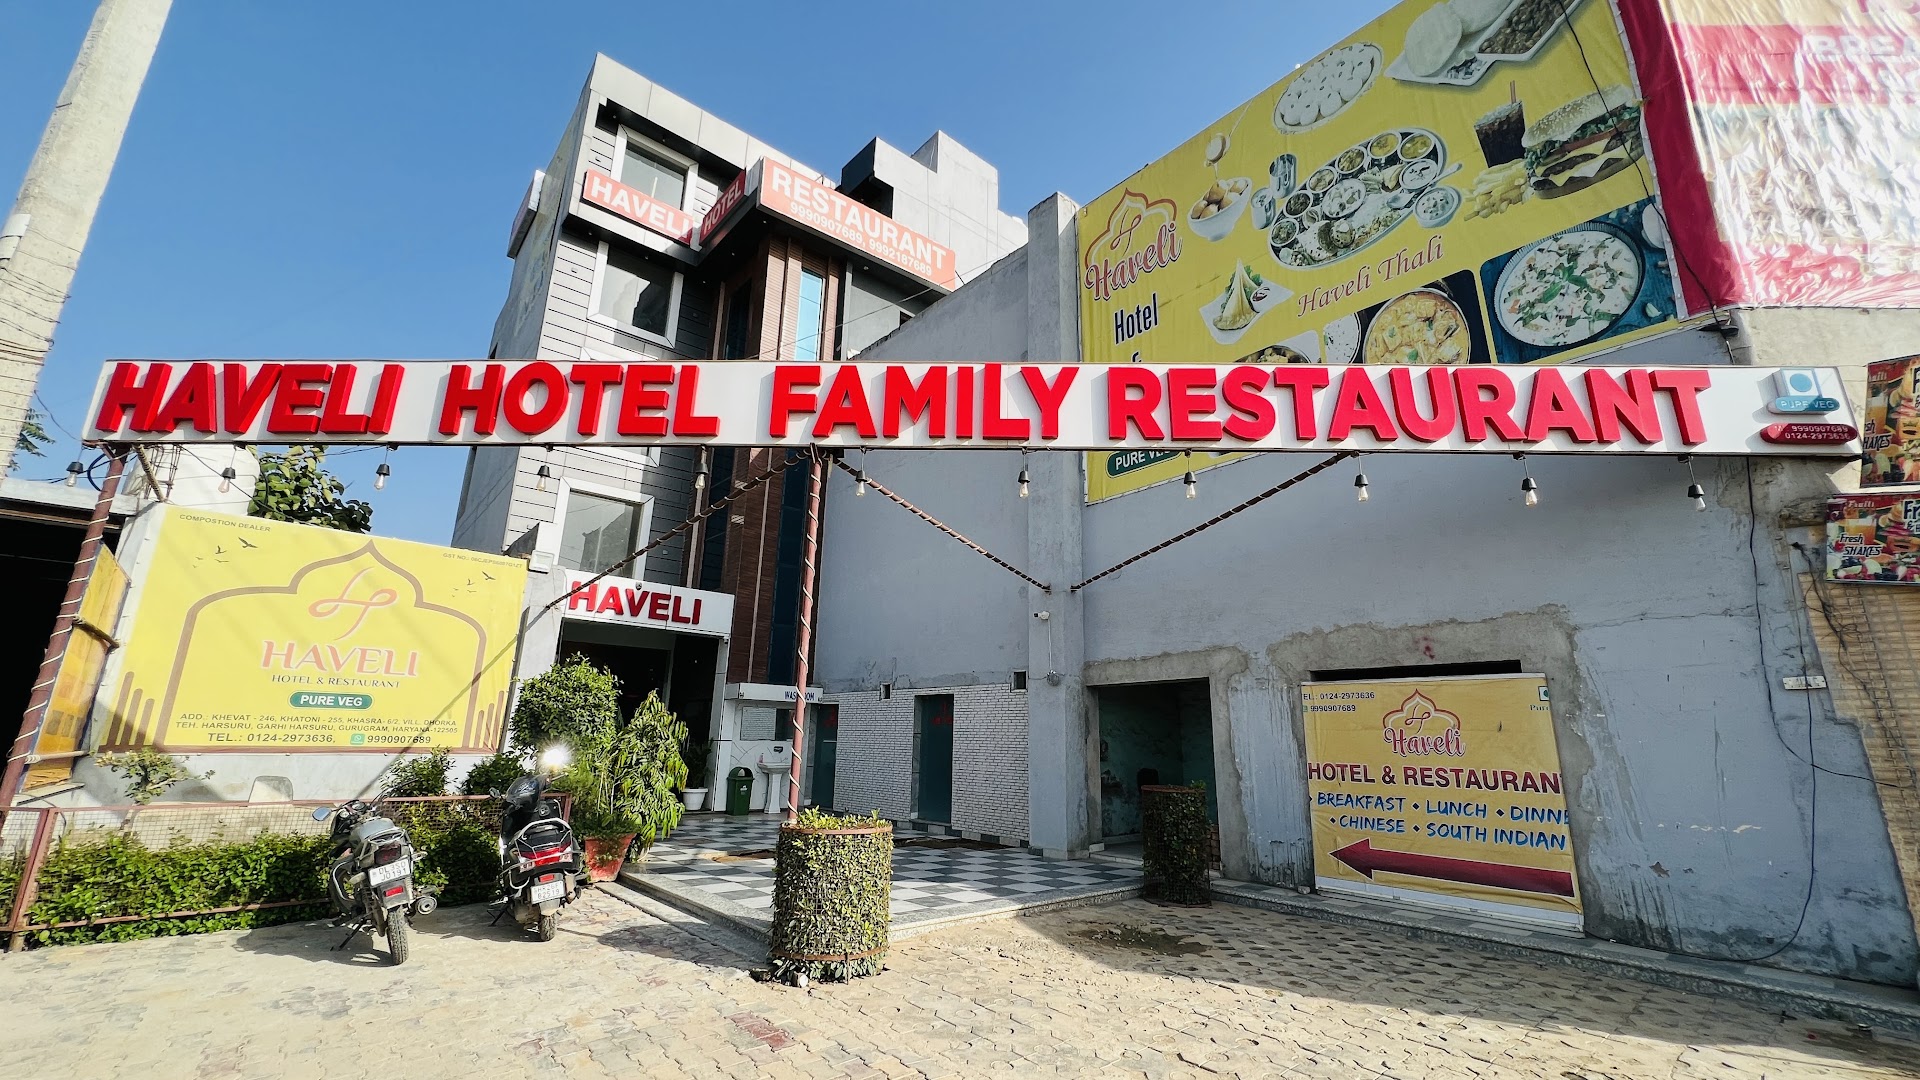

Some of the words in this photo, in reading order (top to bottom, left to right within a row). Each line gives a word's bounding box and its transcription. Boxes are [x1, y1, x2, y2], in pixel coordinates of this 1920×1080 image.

[590, 176, 691, 239] HAVELI
[704, 180, 742, 234] HOTEL
[772, 166, 946, 270] RESTAURANT
[790, 201, 866, 248] 9990907689,
[869, 239, 933, 277] 9992187689
[1085, 223, 1181, 300] Haveli
[1297, 266, 1371, 317] Haveli
[1378, 235, 1443, 281] Thali
[1114, 293, 1158, 344] Hotel
[95, 362, 405, 435] HAVELI
[438, 362, 721, 436] HOTEL
[769, 363, 1080, 440] FAMILY
[1107, 366, 1711, 445] RESTAURANT
[1781, 400, 1809, 409] PURE
[1813, 400, 1834, 409] VEG
[1863, 435, 1892, 450] HAKES
[1115, 451, 1146, 470] PURE
[180, 514, 237, 527] COMPOSTION
[238, 521, 271, 532] DEALER
[1840, 533, 1863, 544] Fresh
[1843, 546, 1882, 557] SHAKES
[568, 580, 702, 625] HAVELI
[262, 640, 418, 677] HAVELI
[272, 674, 313, 685] HOTEL
[316, 677, 324, 685] &
[328, 677, 400, 688] RESTAURANT
[1319, 692, 1375, 700] 0124-2973636
[300, 694, 335, 706] PURE
[337, 696, 363, 707] VEG
[1310, 704, 1356, 712] 9990907689
[176, 721, 199, 729] TEH.
[201, 722, 254, 730] HARSURU,
[338, 724, 390, 732] GURUGRAM,
[367, 735, 432, 744] 9990907689
[1384, 727, 1464, 757] Haveli
[1307, 762, 1375, 784] HOTEL
[1381, 765, 1397, 785] &
[1403, 766, 1563, 794] RESTAURAN
[1317, 791, 1406, 812] BREAKFAST
[1426, 800, 1487, 819] LUNCH
[1510, 805, 1570, 825] DINNE
[1339, 814, 1405, 833] CHINESE
[1426, 822, 1487, 842] SOUTH
[1494, 828, 1566, 850] INDIAN
